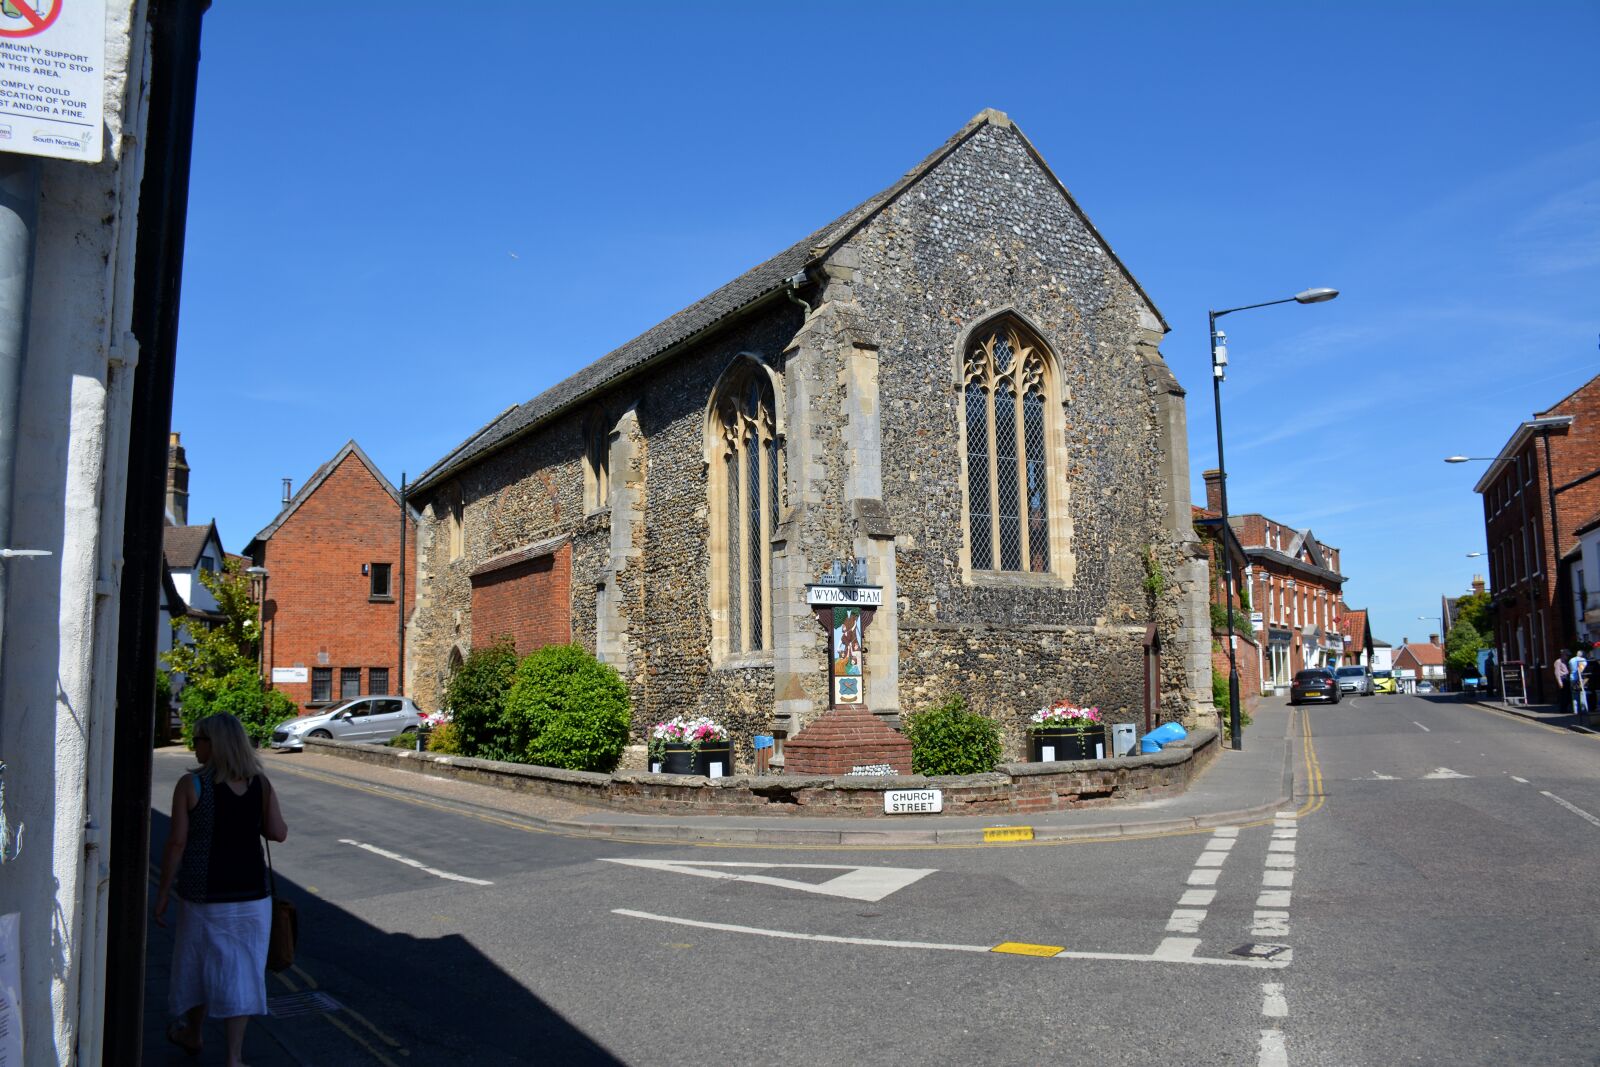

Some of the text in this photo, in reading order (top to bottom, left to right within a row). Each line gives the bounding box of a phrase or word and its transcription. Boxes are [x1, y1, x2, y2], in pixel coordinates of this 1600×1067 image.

[45, 49, 88, 63] SUPPORT
[8, 63, 30, 73] THIS
[33, 67, 61, 78] AREA.
[31, 57, 51, 66] YOU
[54, 60, 66, 69] TO
[69, 63, 94, 73] STOP
[1, 79, 70, 97] OMPLY COULD
[45, 96, 58, 104] OF
[61, 98, 87, 109] YOUR
[12, 101, 49, 113] AND/OR
[52, 107, 59, 115] A
[61, 109, 85, 119] FINE.
[32, 135, 81, 148] South Norfolk
[813, 588, 881, 603] WYMONDHAM
[892, 792, 935, 802] CHURCH
[892, 802, 934, 812] STREET
